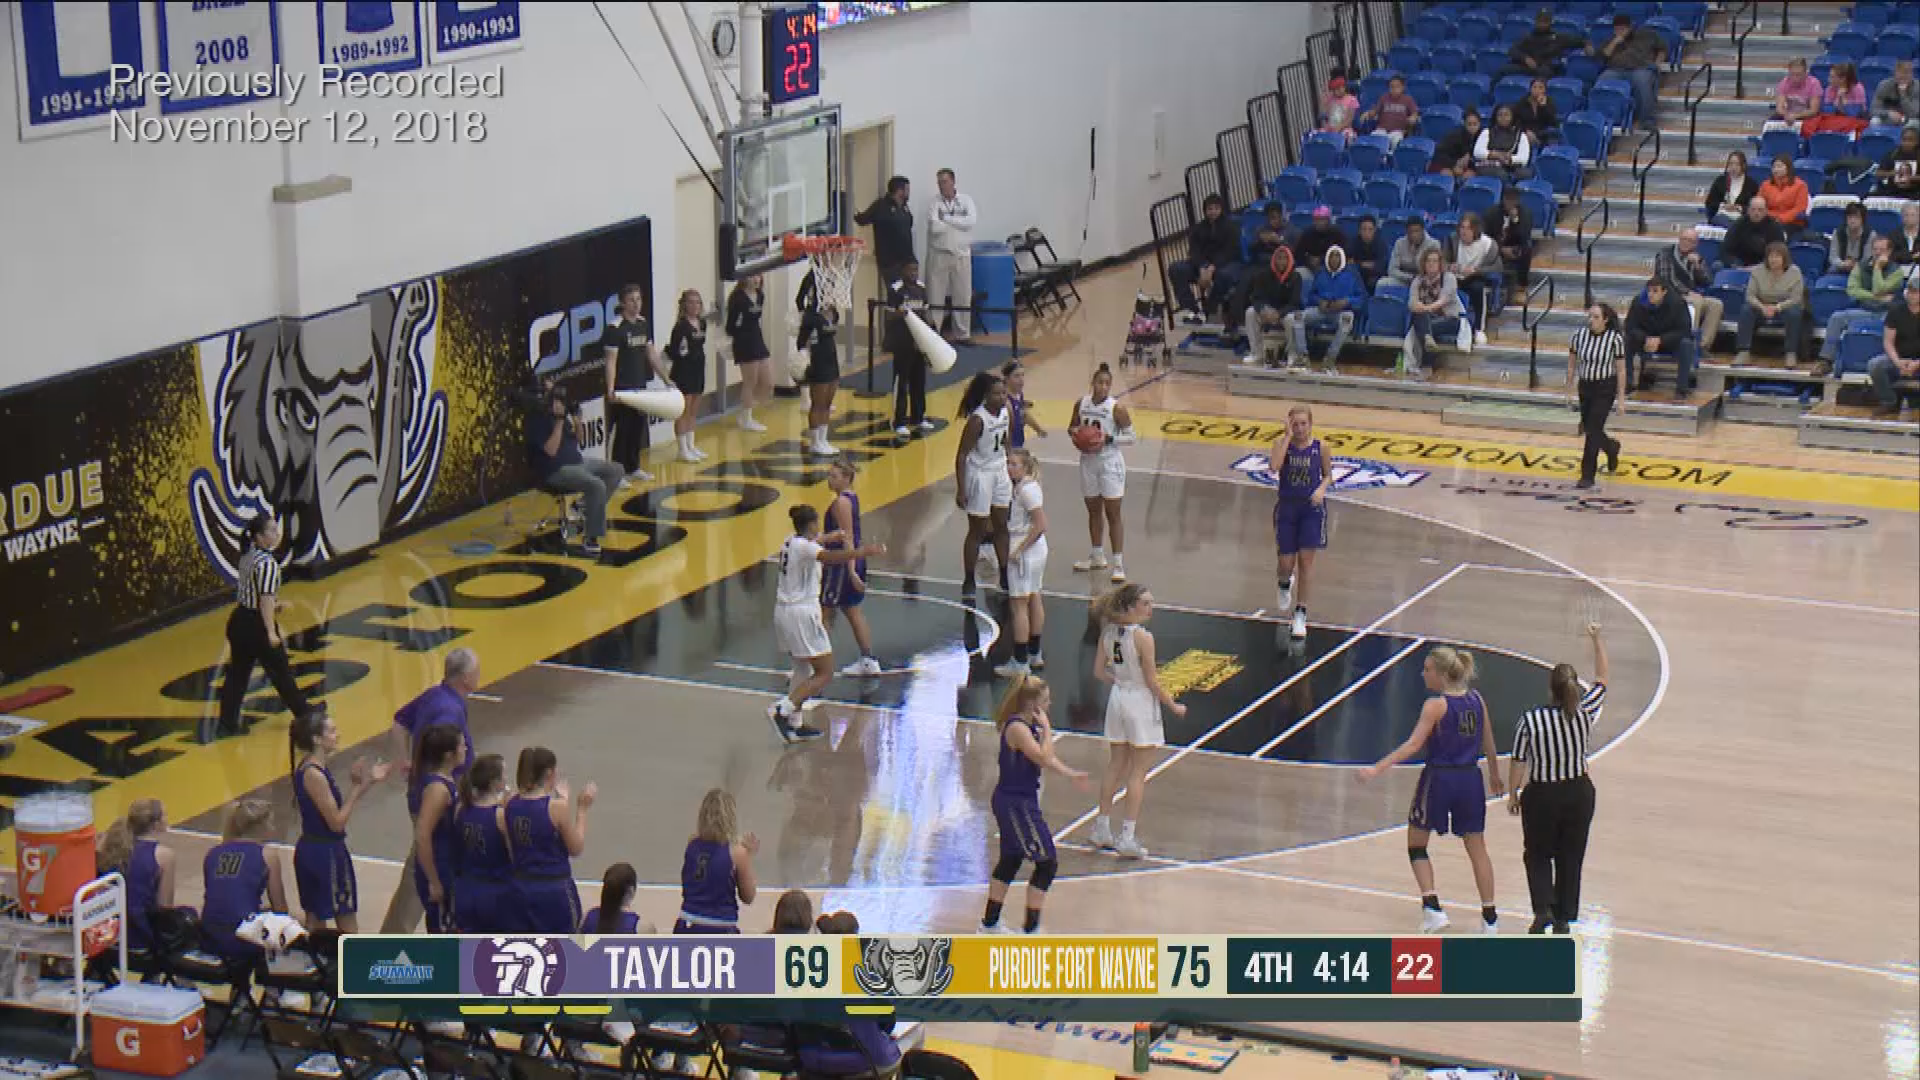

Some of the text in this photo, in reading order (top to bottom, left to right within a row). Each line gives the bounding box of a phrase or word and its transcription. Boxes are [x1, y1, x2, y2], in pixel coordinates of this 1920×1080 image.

[443, 15, 515, 45] 1990-1993
[785, 13, 817, 38] 4:14
[194, 35, 249, 65] 2008
[332, 35, 410, 63] 1989-1992
[784, 41, 812, 93] 22
[1160, 417, 1733, 487] GOMSTODONSCOM
[4, 518, 80, 562] WAYNE
[215, 851, 245, 879] 30
[115, 1027, 141, 1057] G
